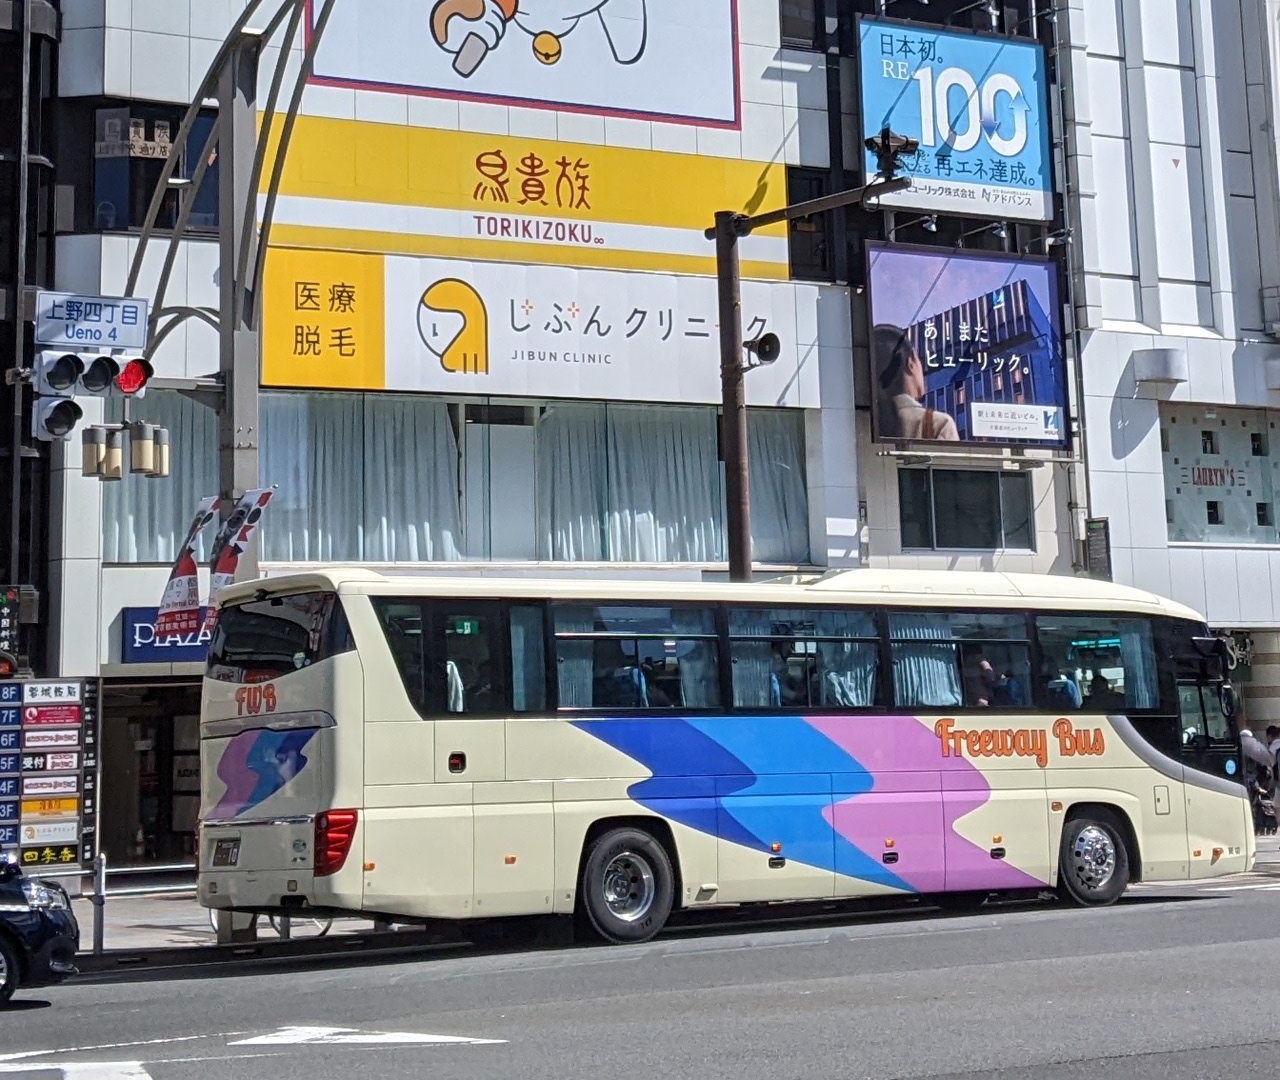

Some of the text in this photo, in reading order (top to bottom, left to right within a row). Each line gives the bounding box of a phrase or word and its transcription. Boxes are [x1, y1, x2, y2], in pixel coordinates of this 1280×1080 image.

[879, 33, 944, 64] 日本初。
[473, 149, 592, 210] 鳥貴族
[934, 154, 1036, 186] 再エネ達成。
[473, 215, 592, 243] TORIKIZOKU
[294, 282, 356, 314] 医療
[44, 299, 140, 326] 上野四丁目
[510, 298, 768, 341] じぶんクリニク
[65, 325, 119, 342] Ueno 4
[293, 326, 356, 357] 脱毛
[511, 349, 612, 365] JIBUN CLINIC
[2, 686, 17, 699] 8F
[235, 683, 277, 716] FWB
[1, 710, 16, 723] 7F
[1, 733, 15, 746] 6F
[935, 718, 1106, 767] Freeway Bus
[0, 757, 15, 770] 5F
[22, 757, 45, 769] 受付
[0, 781, 15, 794] 4F
[0, 828, 14, 841] 2F
[23, 847, 76, 863] 四季香
